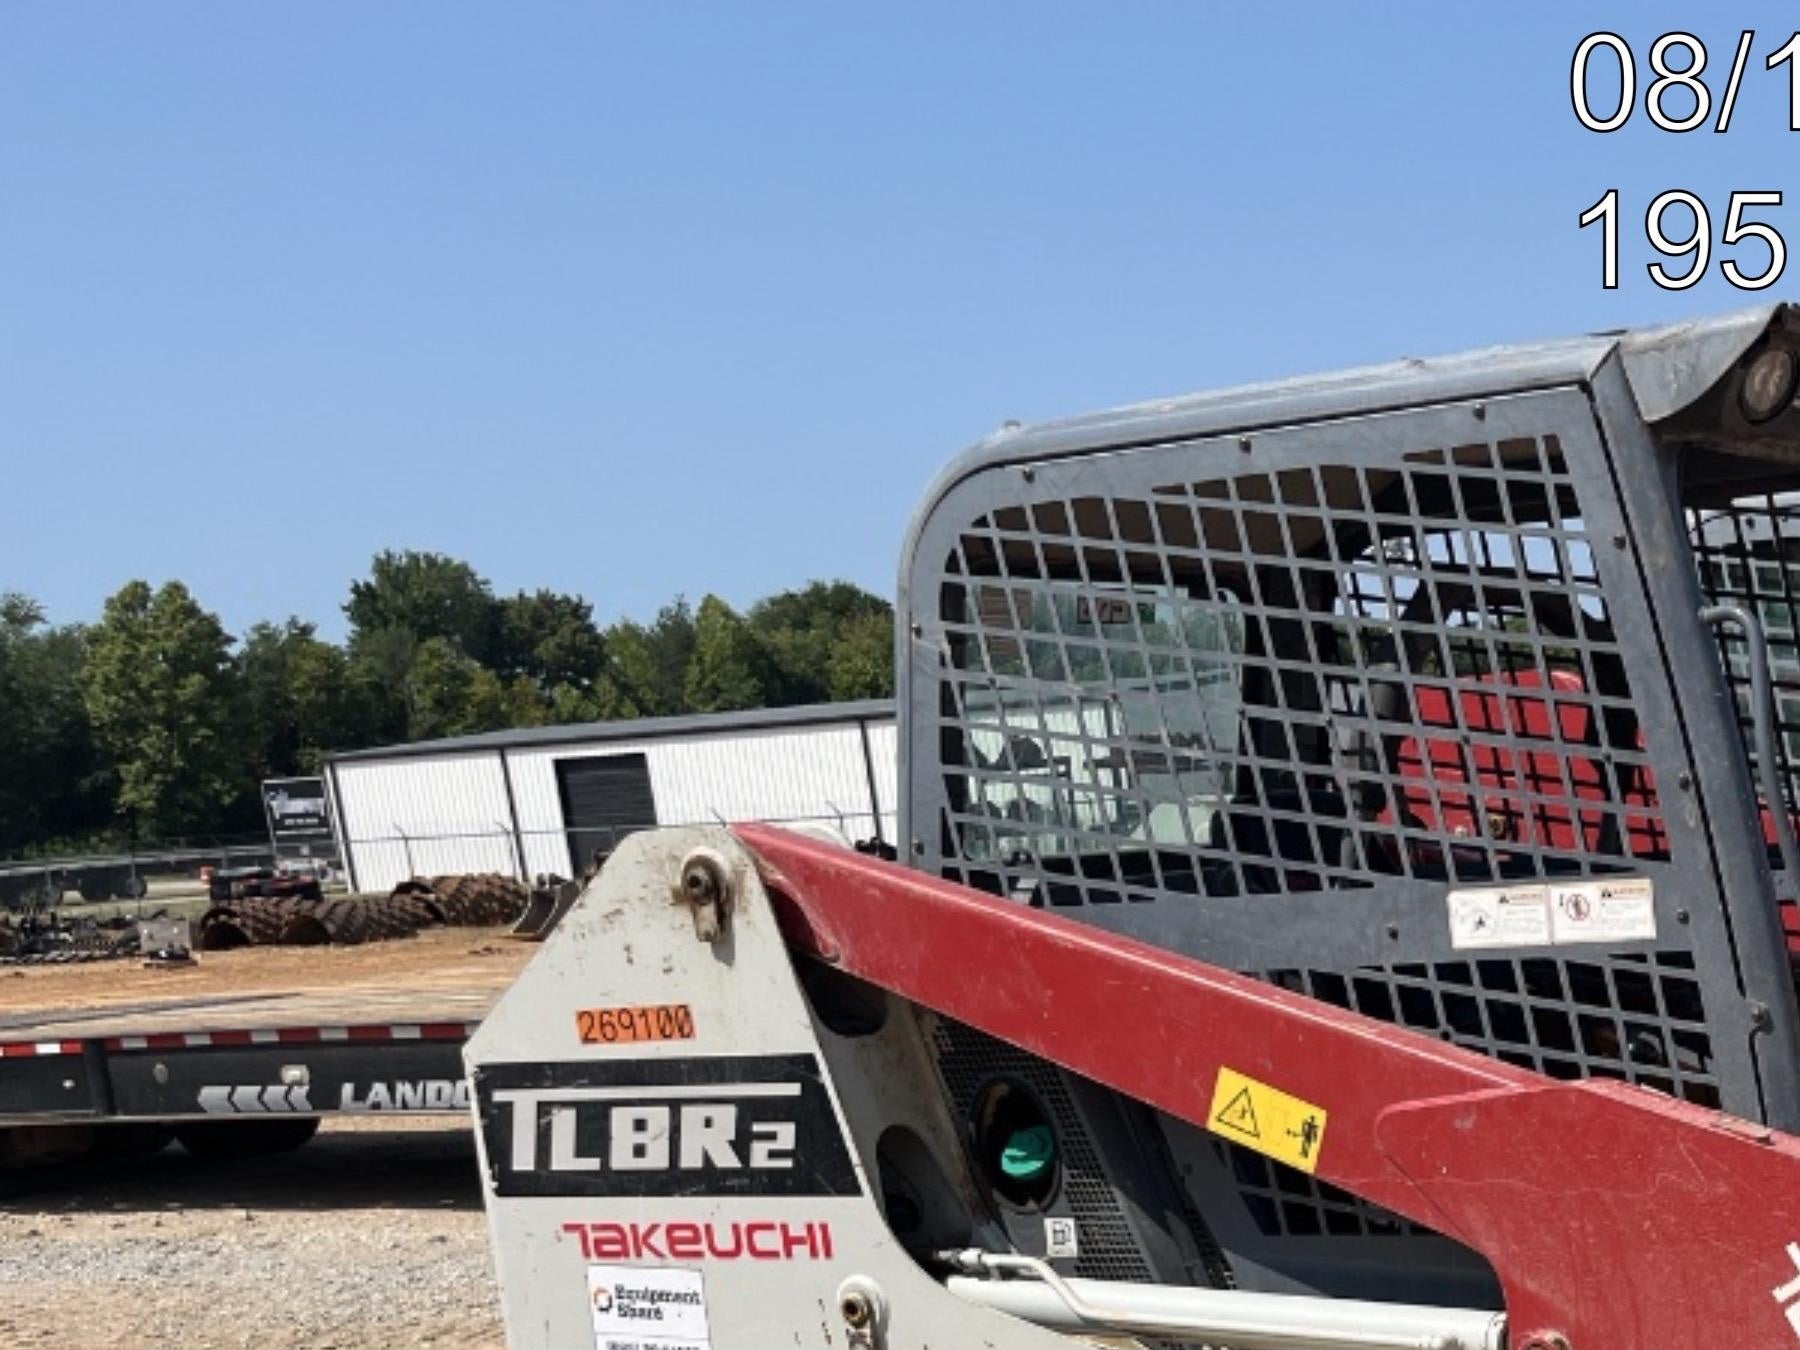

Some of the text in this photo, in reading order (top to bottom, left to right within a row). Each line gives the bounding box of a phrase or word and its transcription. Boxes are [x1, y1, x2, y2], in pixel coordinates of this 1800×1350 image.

[577, 1004, 695, 1043] 269100
[491, 1082, 802, 1172] TL8R2
[562, 1222, 834, 1260] TAKEUCHI
